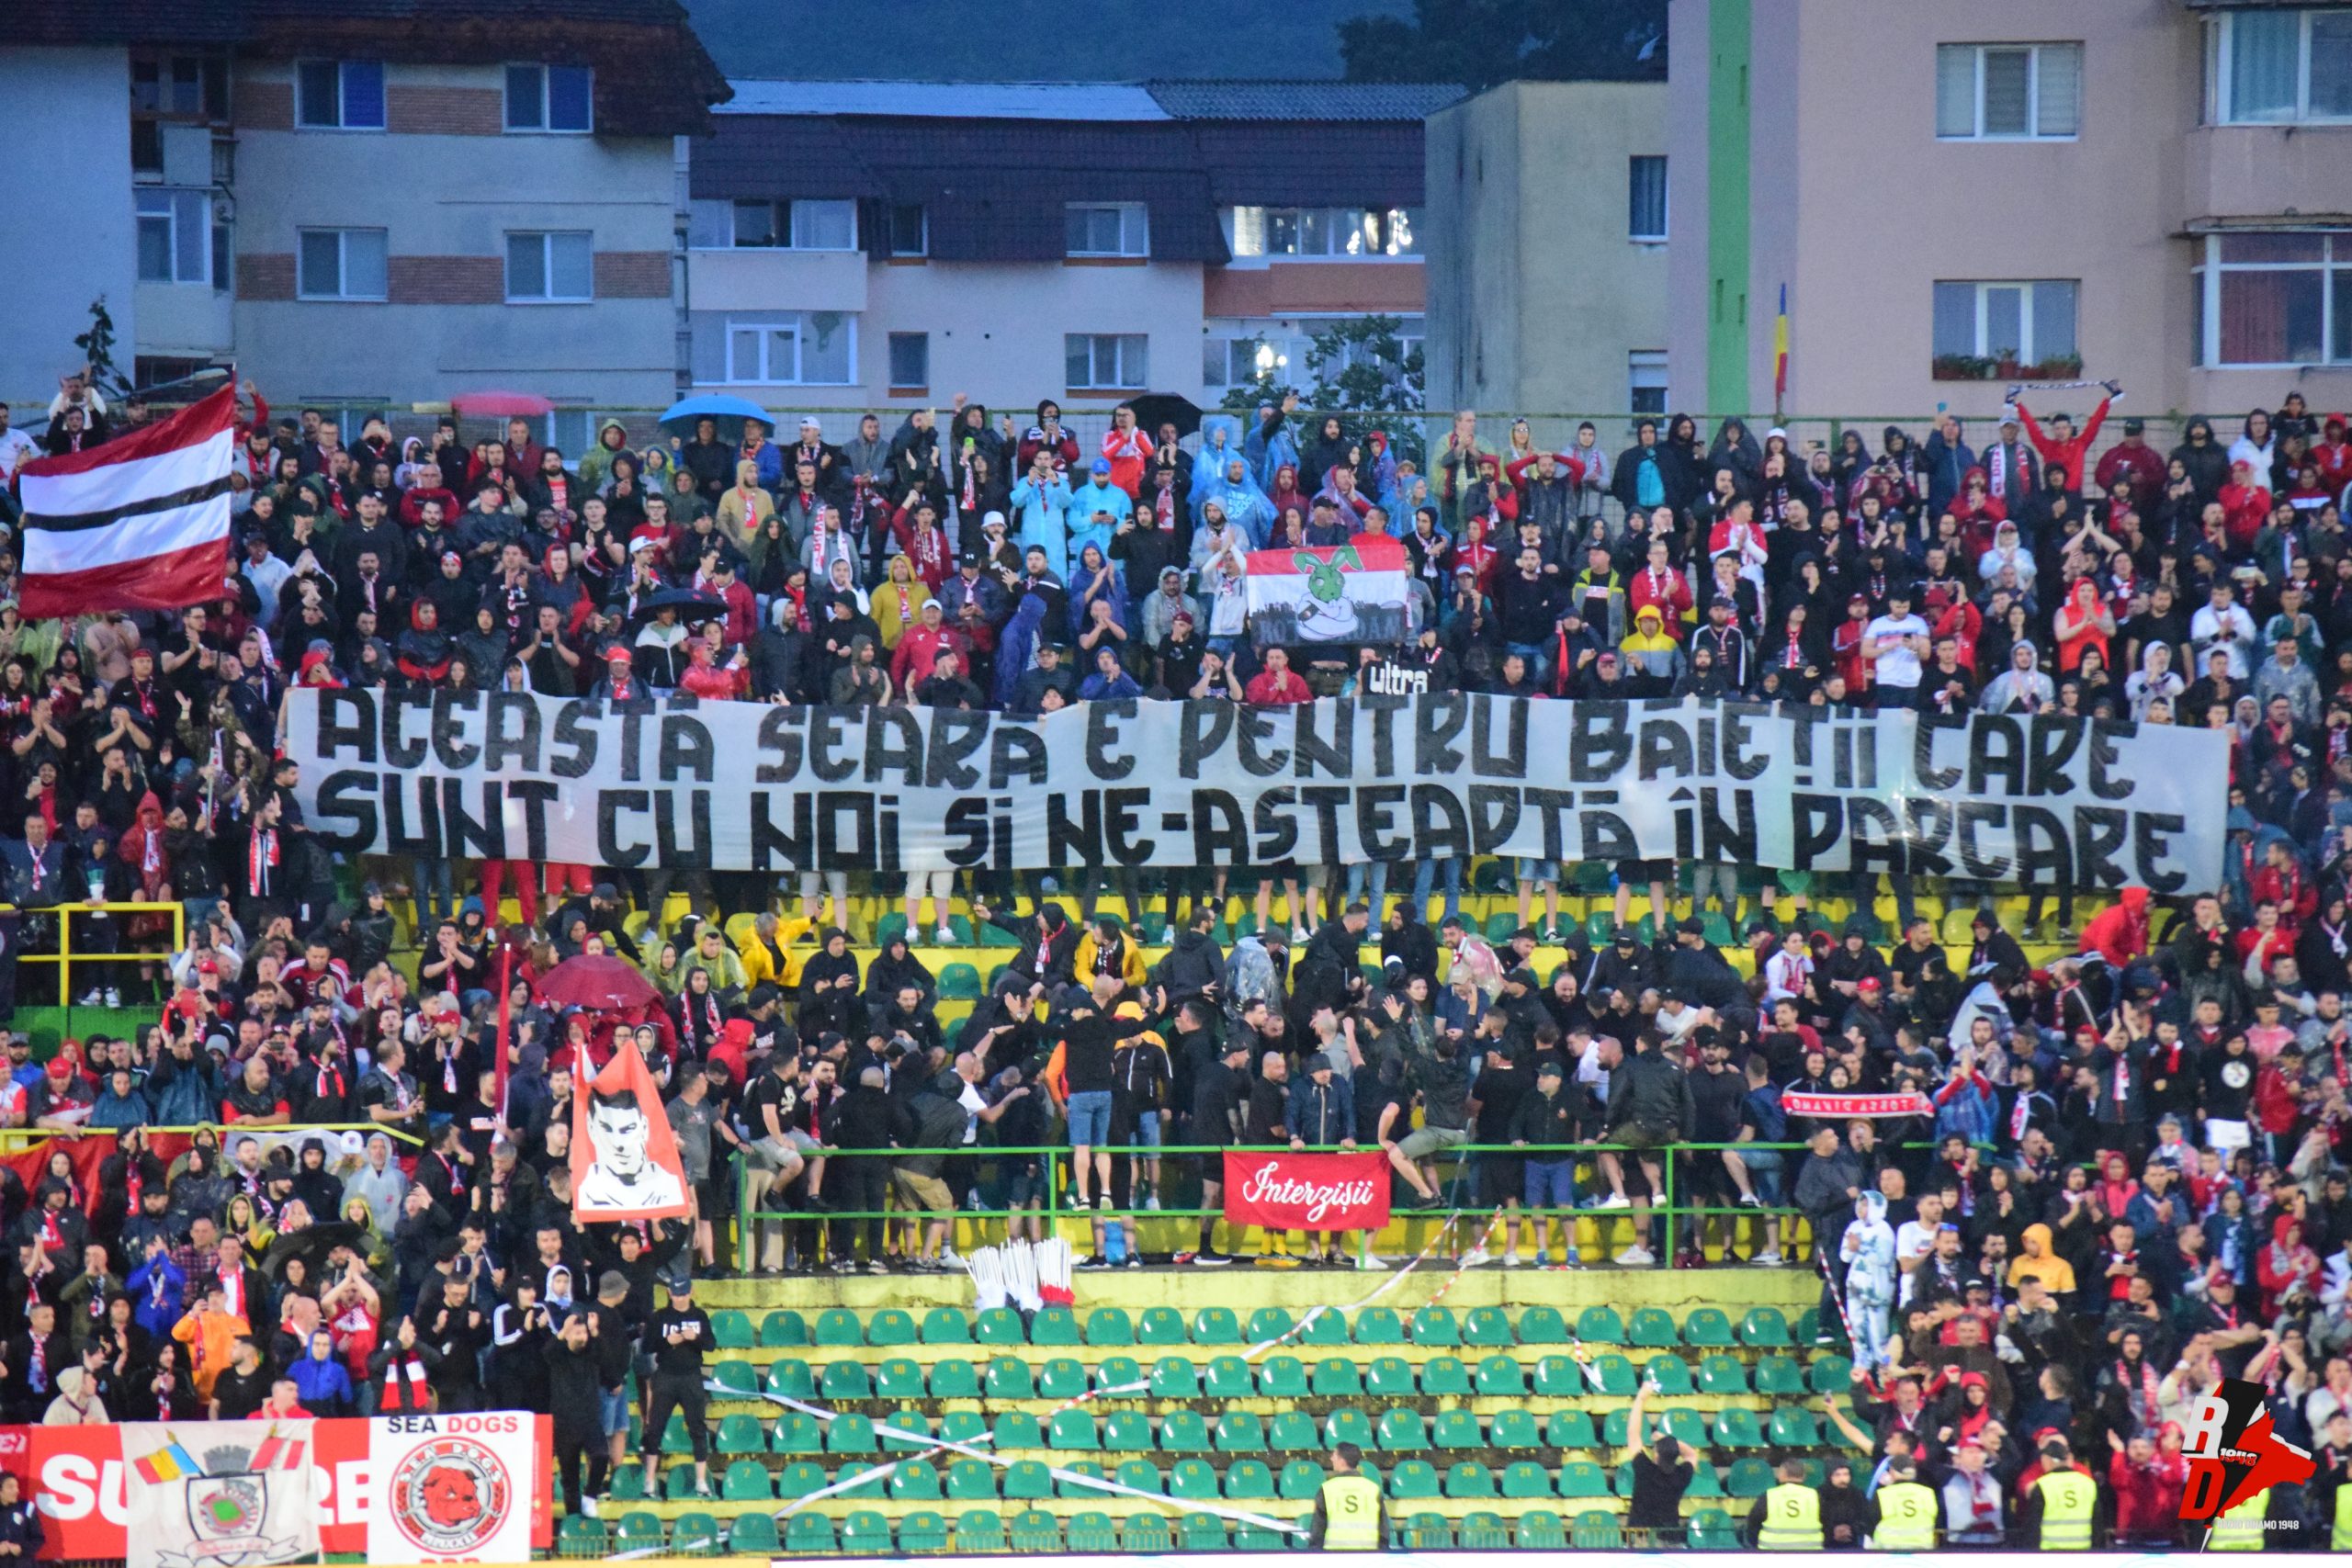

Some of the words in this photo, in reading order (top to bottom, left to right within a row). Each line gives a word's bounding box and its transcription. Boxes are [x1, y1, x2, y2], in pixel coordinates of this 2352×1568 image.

[1086, 697, 1137, 780] E
[1179, 692, 1529, 779] PENTRU
[1914, 712, 2138, 800] CARE
[316, 770, 559, 860] SUNT
[598, 789, 713, 869] CU
[1668, 786, 1758, 863] ÎN
[1792, 793, 2188, 893] PARCARE
[388, 1416, 437, 1433] SEA
[447, 1416, 518, 1433] DOGS
[1345, 1495, 1359, 1514] S
[1786, 1499, 1800, 1517] S
[1903, 1499, 1917, 1517] S
[2064, 1490, 2077, 1508] S
